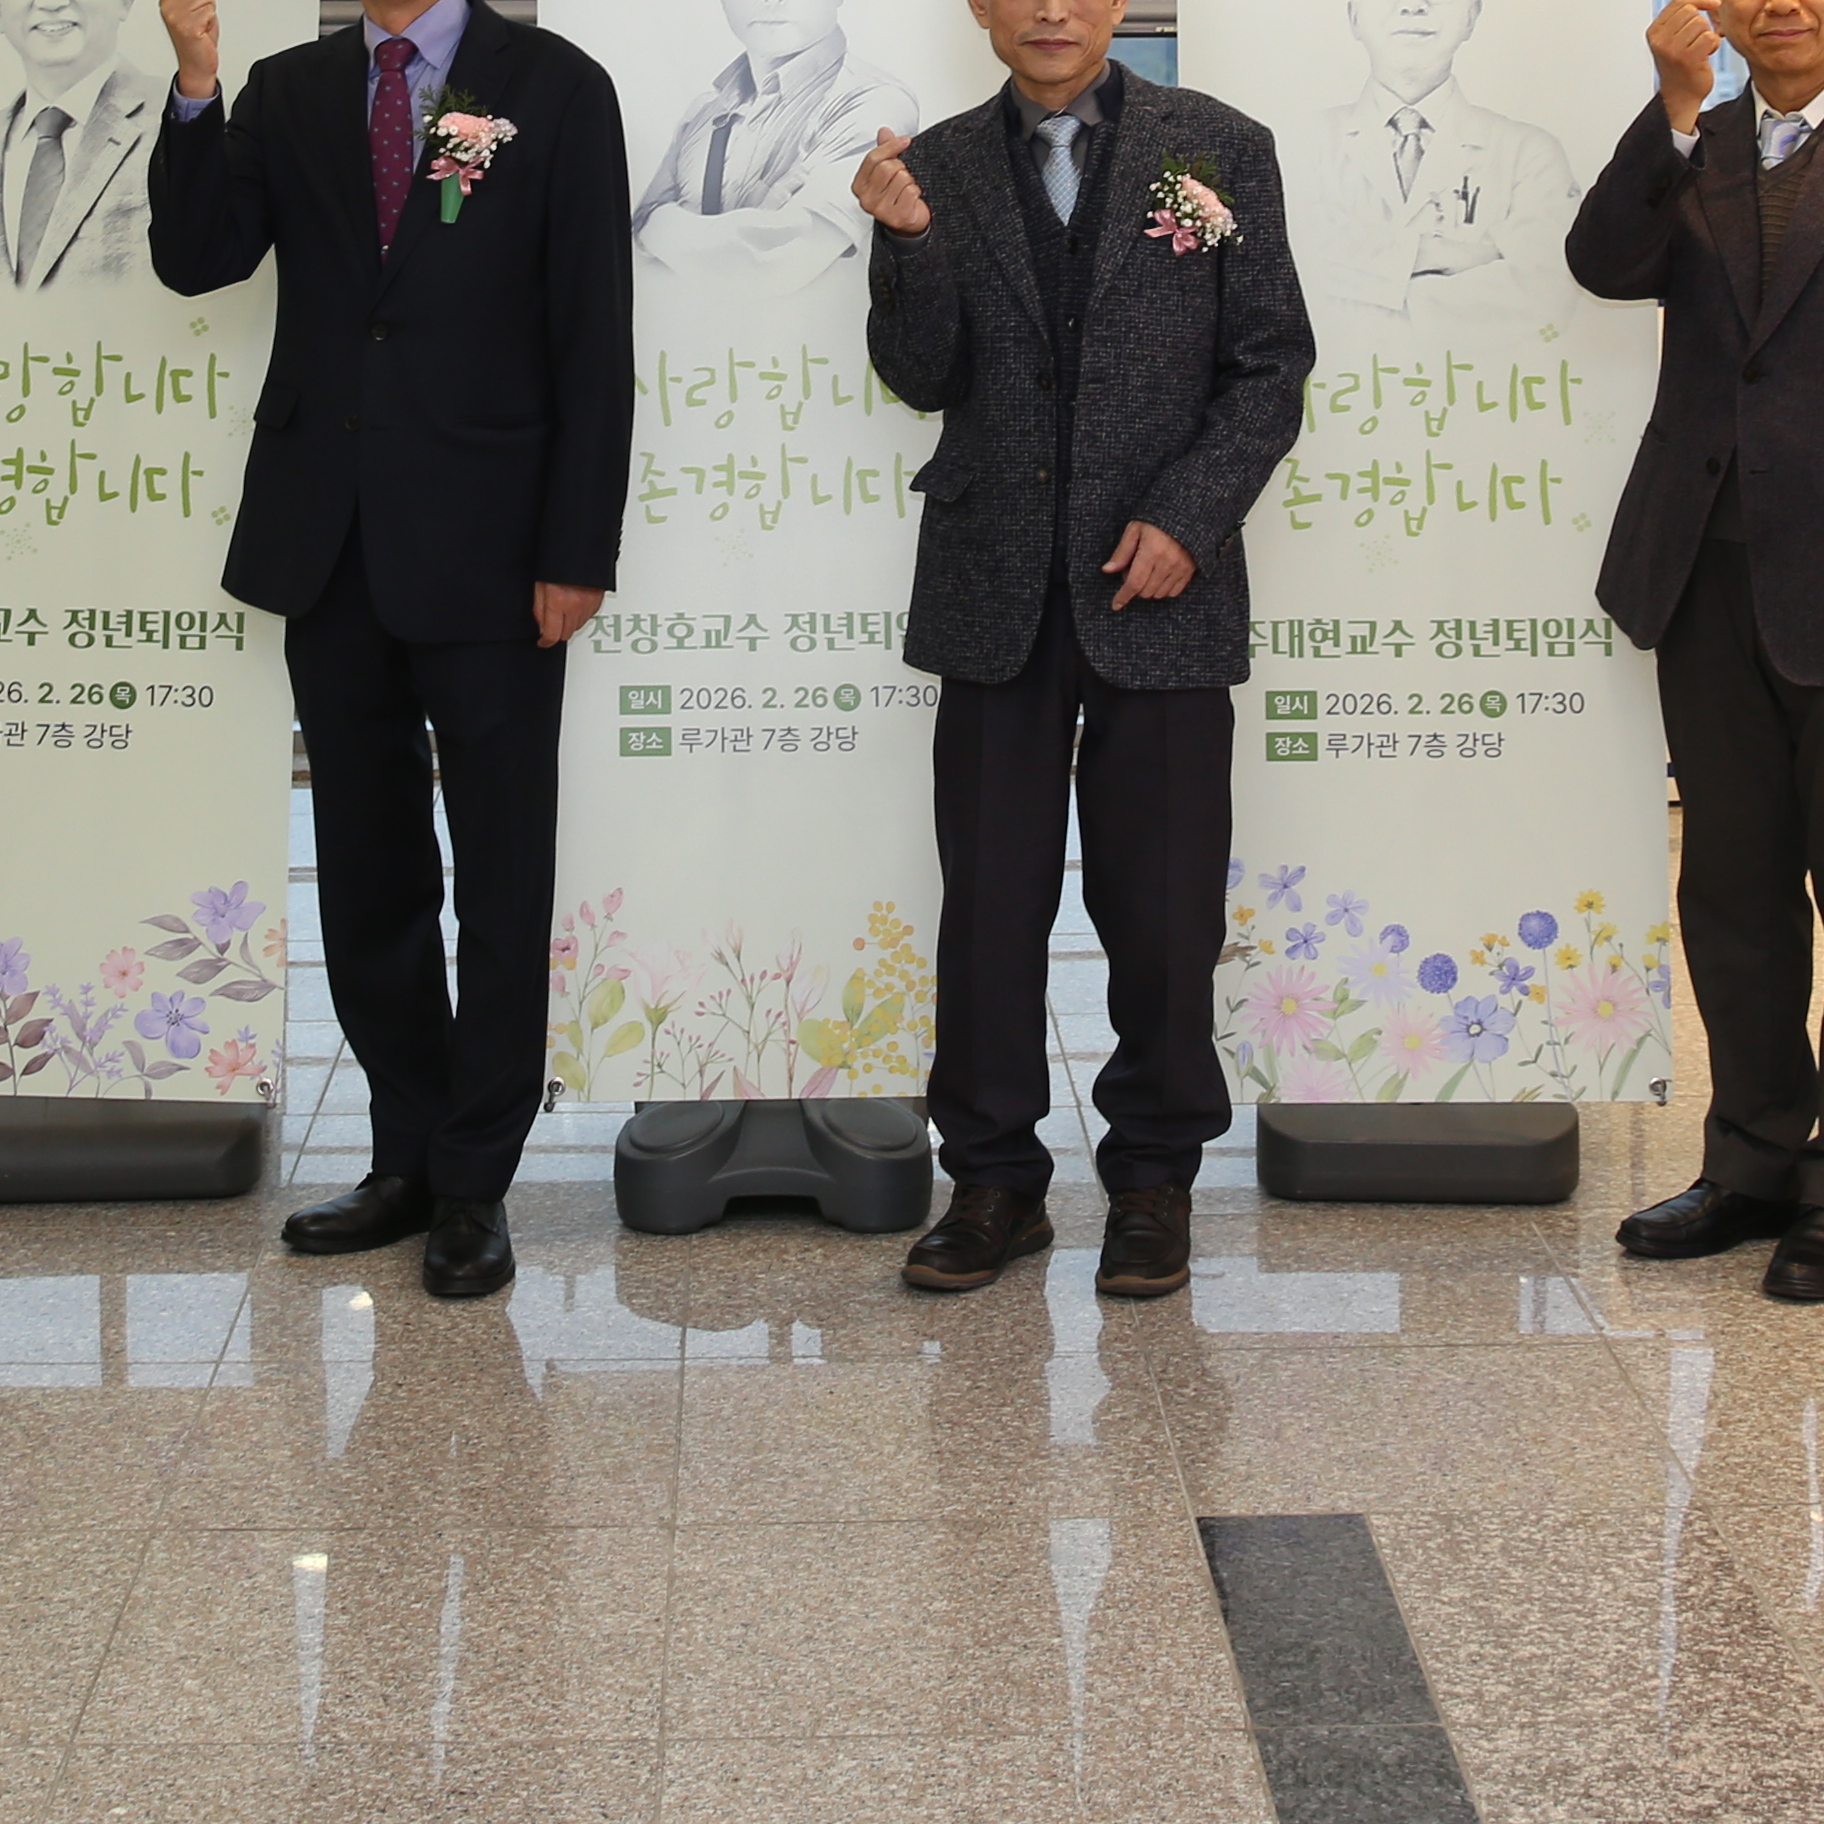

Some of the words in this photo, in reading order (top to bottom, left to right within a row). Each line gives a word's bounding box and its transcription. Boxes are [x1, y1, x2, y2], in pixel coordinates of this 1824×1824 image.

[637, 442, 916, 531] 존경합니다
[1282, 448, 1563, 537] 존경합니다
[63, 609, 245, 651] 정년퇴임식
[588, 611, 771, 655] 전창호교수
[1429, 617, 1614, 659] 정년퇴임식
[38, 683, 60, 704] 2.
[70, 683, 103, 705] 26
[147, 685, 213, 707] 17:30
[628, 689, 662, 710] 일시
[680, 688, 752, 709] 2026.
[762, 688, 784, 708] 2.
[795, 687, 827, 708] 26
[871, 685, 939, 709] 17:30
[1274, 694, 1308, 715] 일시
[1326, 693, 1398, 715] 2026.
[1408, 694, 1430, 714] 2.
[1440, 693, 1473, 714] 26
[1517, 692, 1584, 714] 17:30
[37, 722, 74, 748] 7층
[84, 723, 132, 749] 강당
[628, 731, 664, 751] 장소
[680, 727, 753, 753] 루가관
[762, 727, 800, 752] 7층
[811, 726, 858, 751] 강당
[1274, 736, 1310, 756] 장소
[1326, 733, 1399, 758] 루가관
[1408, 733, 1447, 758] 7층
[1457, 732, 1504, 758] 강당
